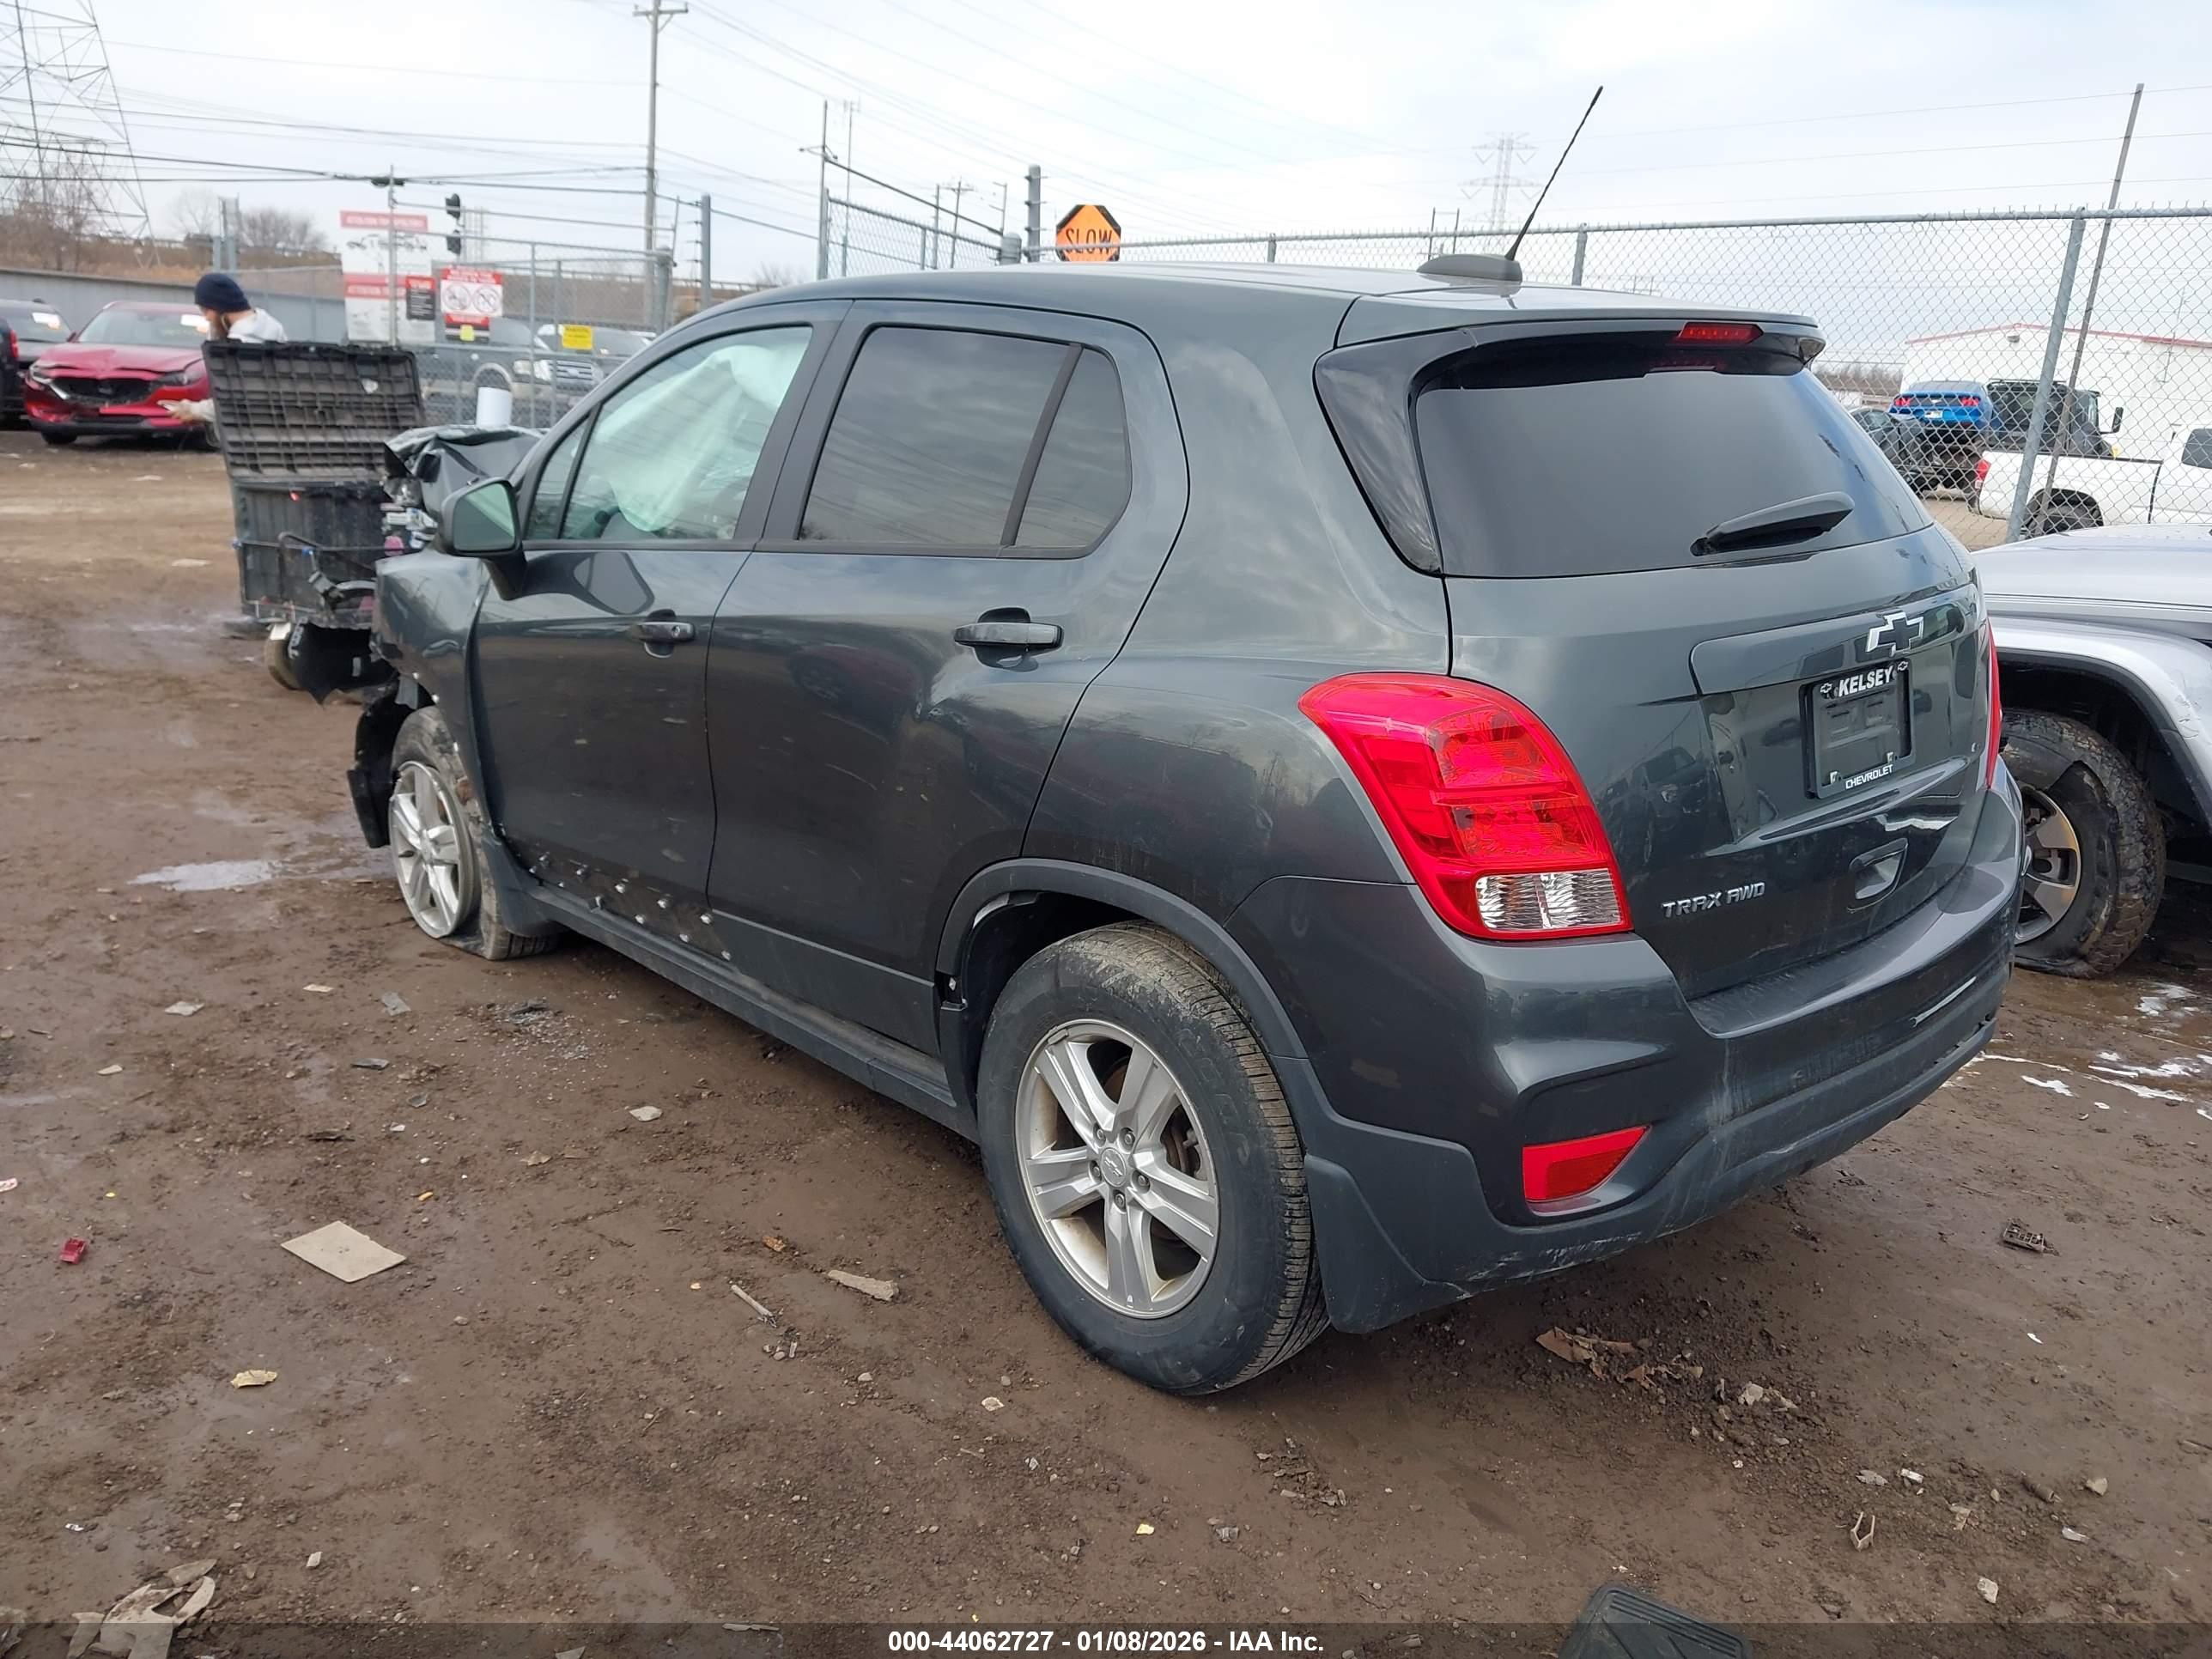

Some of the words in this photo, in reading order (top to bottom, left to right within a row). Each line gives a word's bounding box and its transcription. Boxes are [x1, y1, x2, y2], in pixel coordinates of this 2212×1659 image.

[1066, 228, 1112, 254] SLOW
[1838, 665, 1893, 697] KELSEY
[1845, 763, 1893, 790] CHEVROLET
[1662, 892, 1722, 918] TRAX
[1726, 882, 1765, 904] AWD
